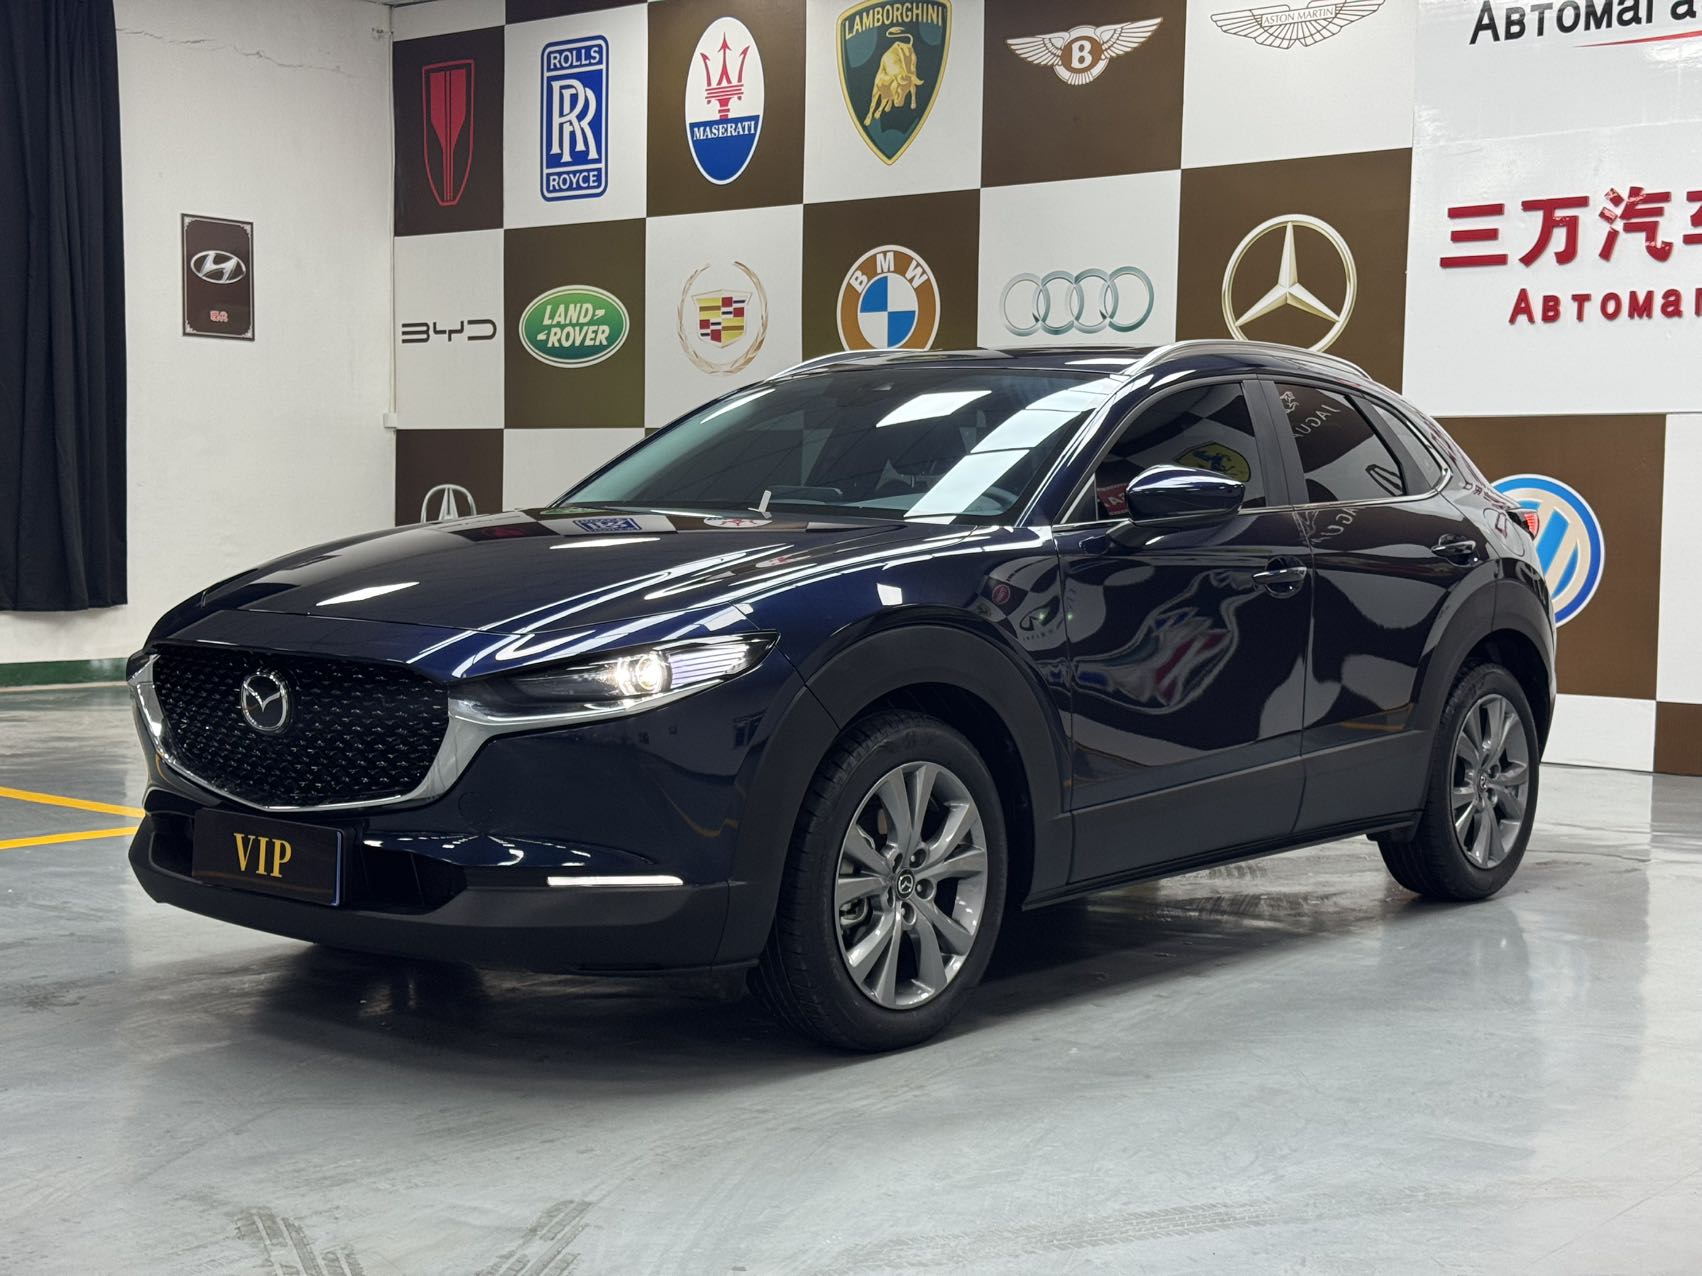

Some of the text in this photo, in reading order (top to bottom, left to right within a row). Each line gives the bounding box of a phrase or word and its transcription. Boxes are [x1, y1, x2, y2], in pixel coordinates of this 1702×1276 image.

[844, 2, 943, 40] LAMBORGHINI
[1263, 7, 1334, 25] ASTON MARTIN
[550, 47, 600, 69] ROLLS
[1071, 40, 1093, 69] B
[693, 121, 756, 140] MASERATI
[549, 171, 598, 190] ROYCE
[849, 251, 928, 294] BMW
[402, 319, 497, 344] BYD
[233, 832, 292, 878] VIP
